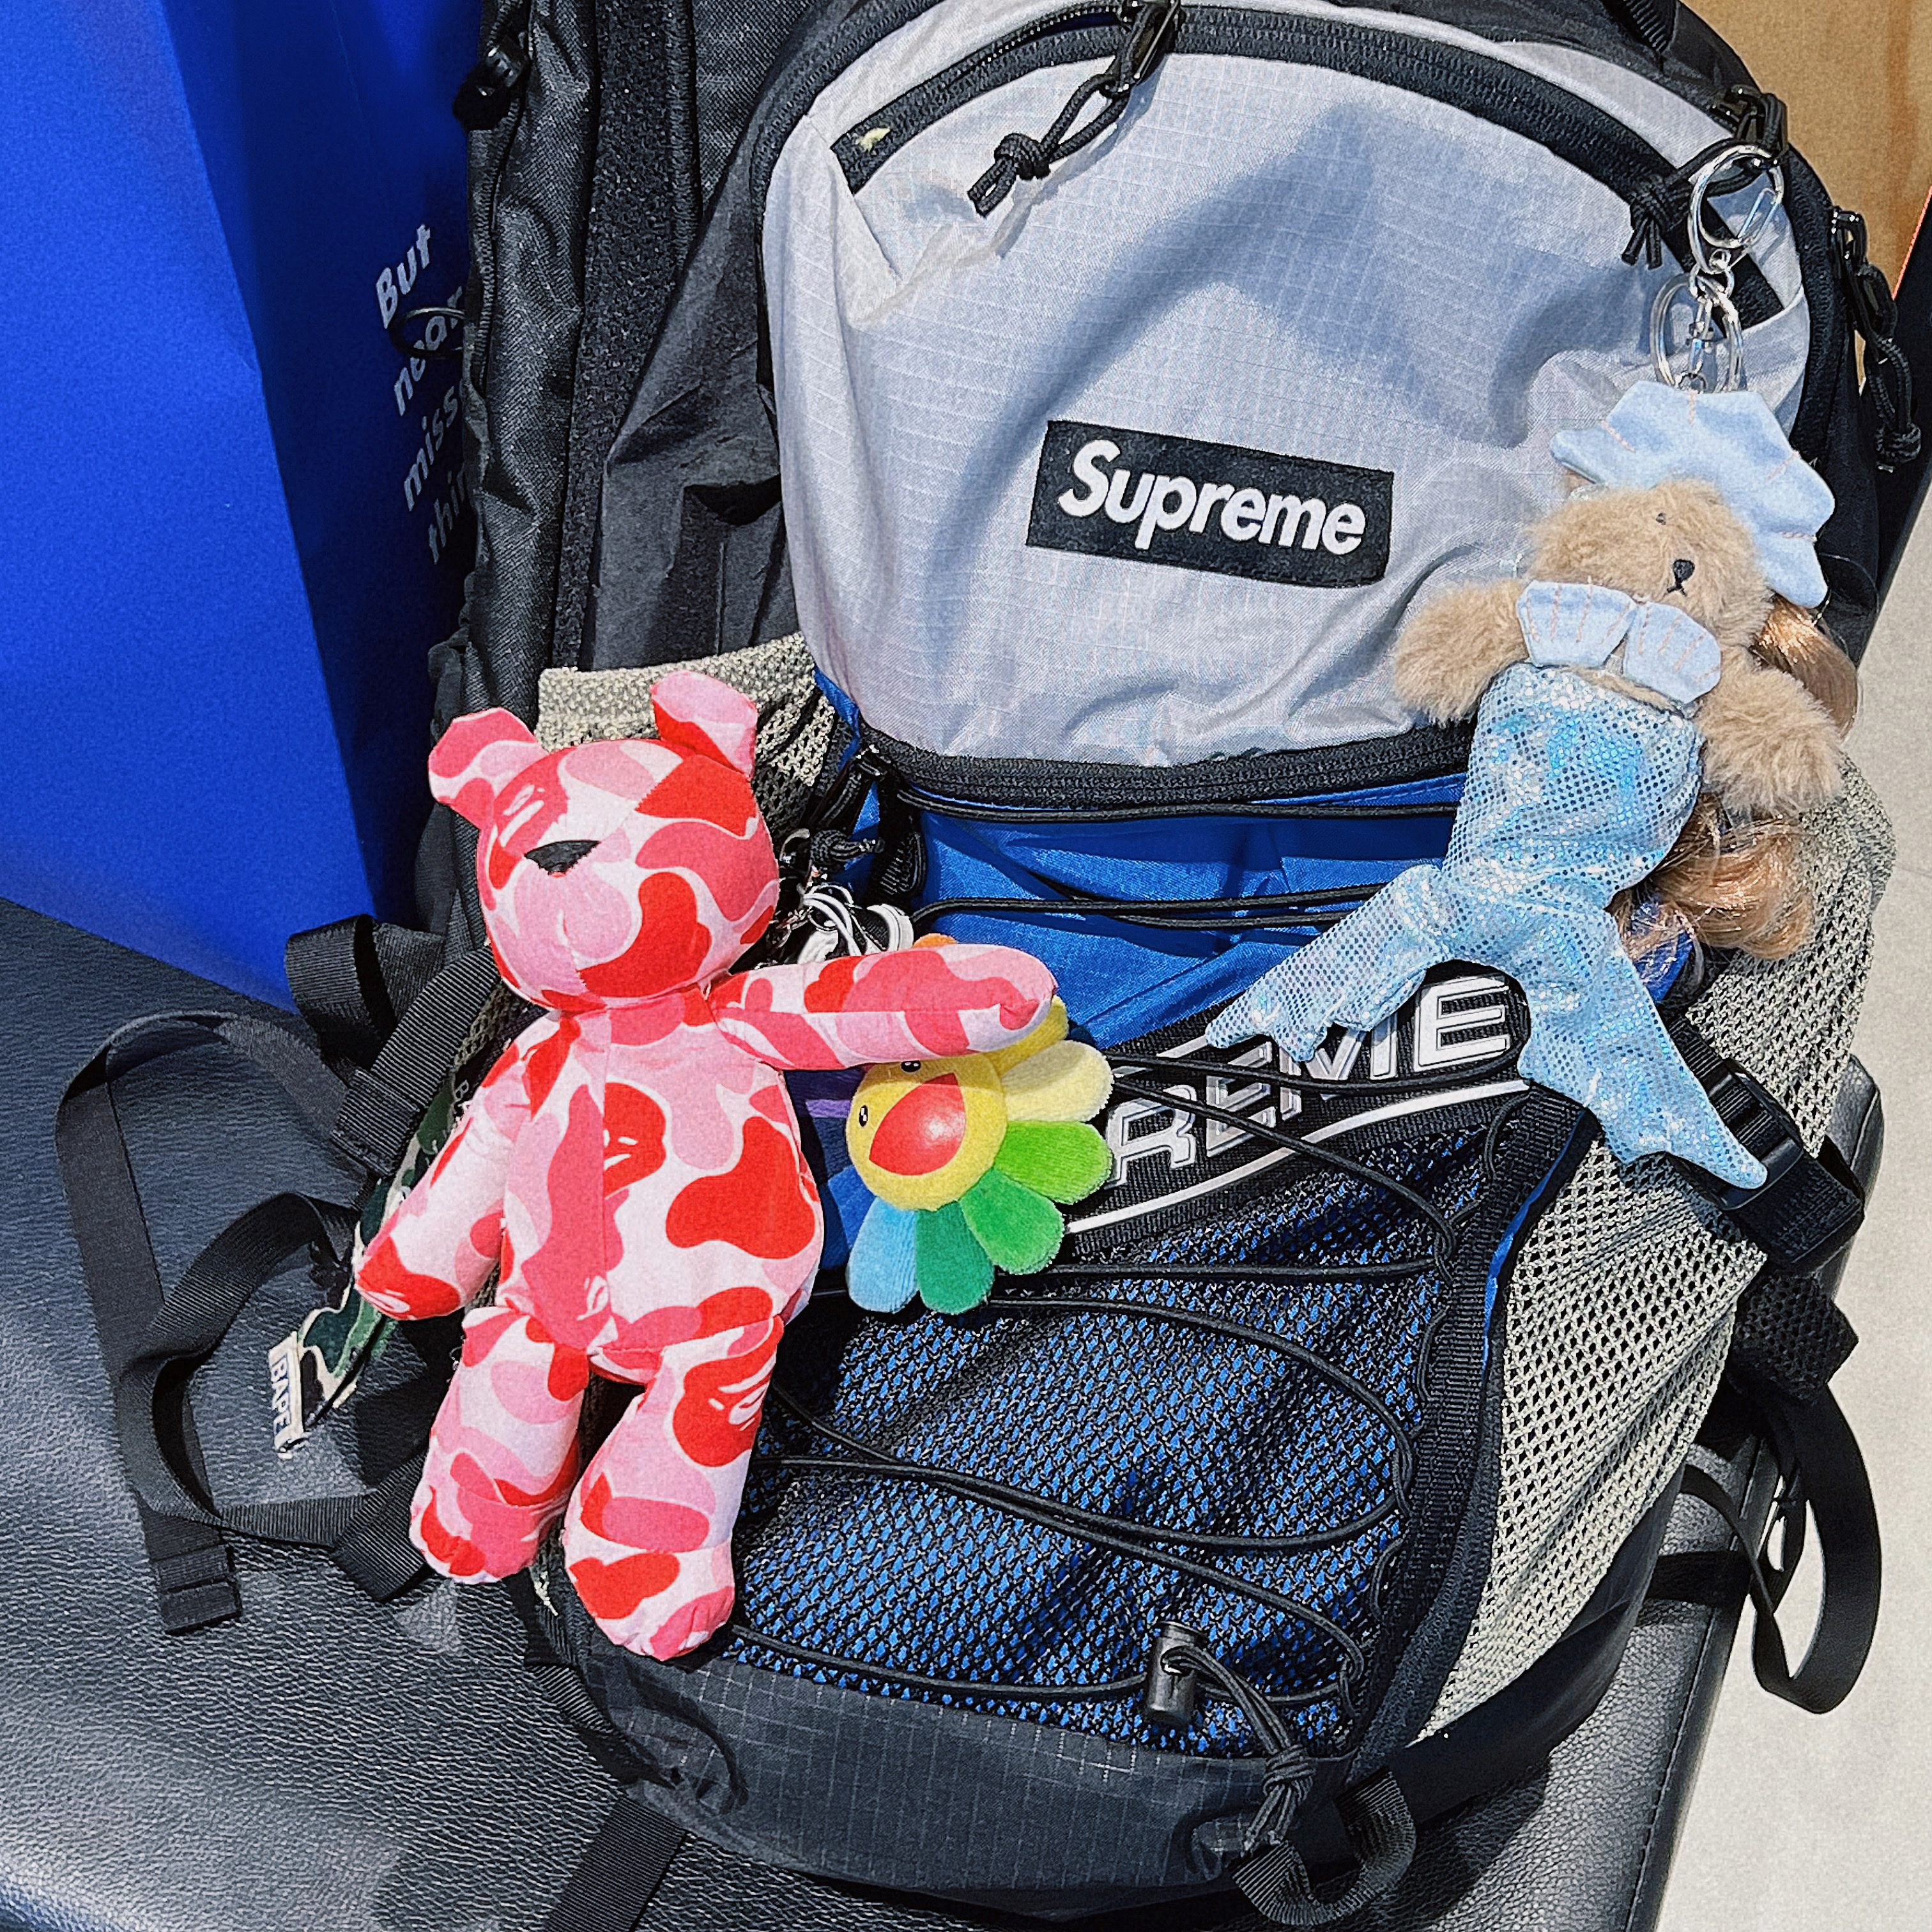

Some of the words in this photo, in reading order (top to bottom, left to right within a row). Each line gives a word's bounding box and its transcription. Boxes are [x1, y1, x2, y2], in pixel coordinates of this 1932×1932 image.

[376, 224, 430, 328] But
[404, 385, 458, 511] miss
[1058, 439, 1366, 555] Supreme
[1105, 975, 1510, 1190] REME
[271, 1355, 292, 1436] BAPE
